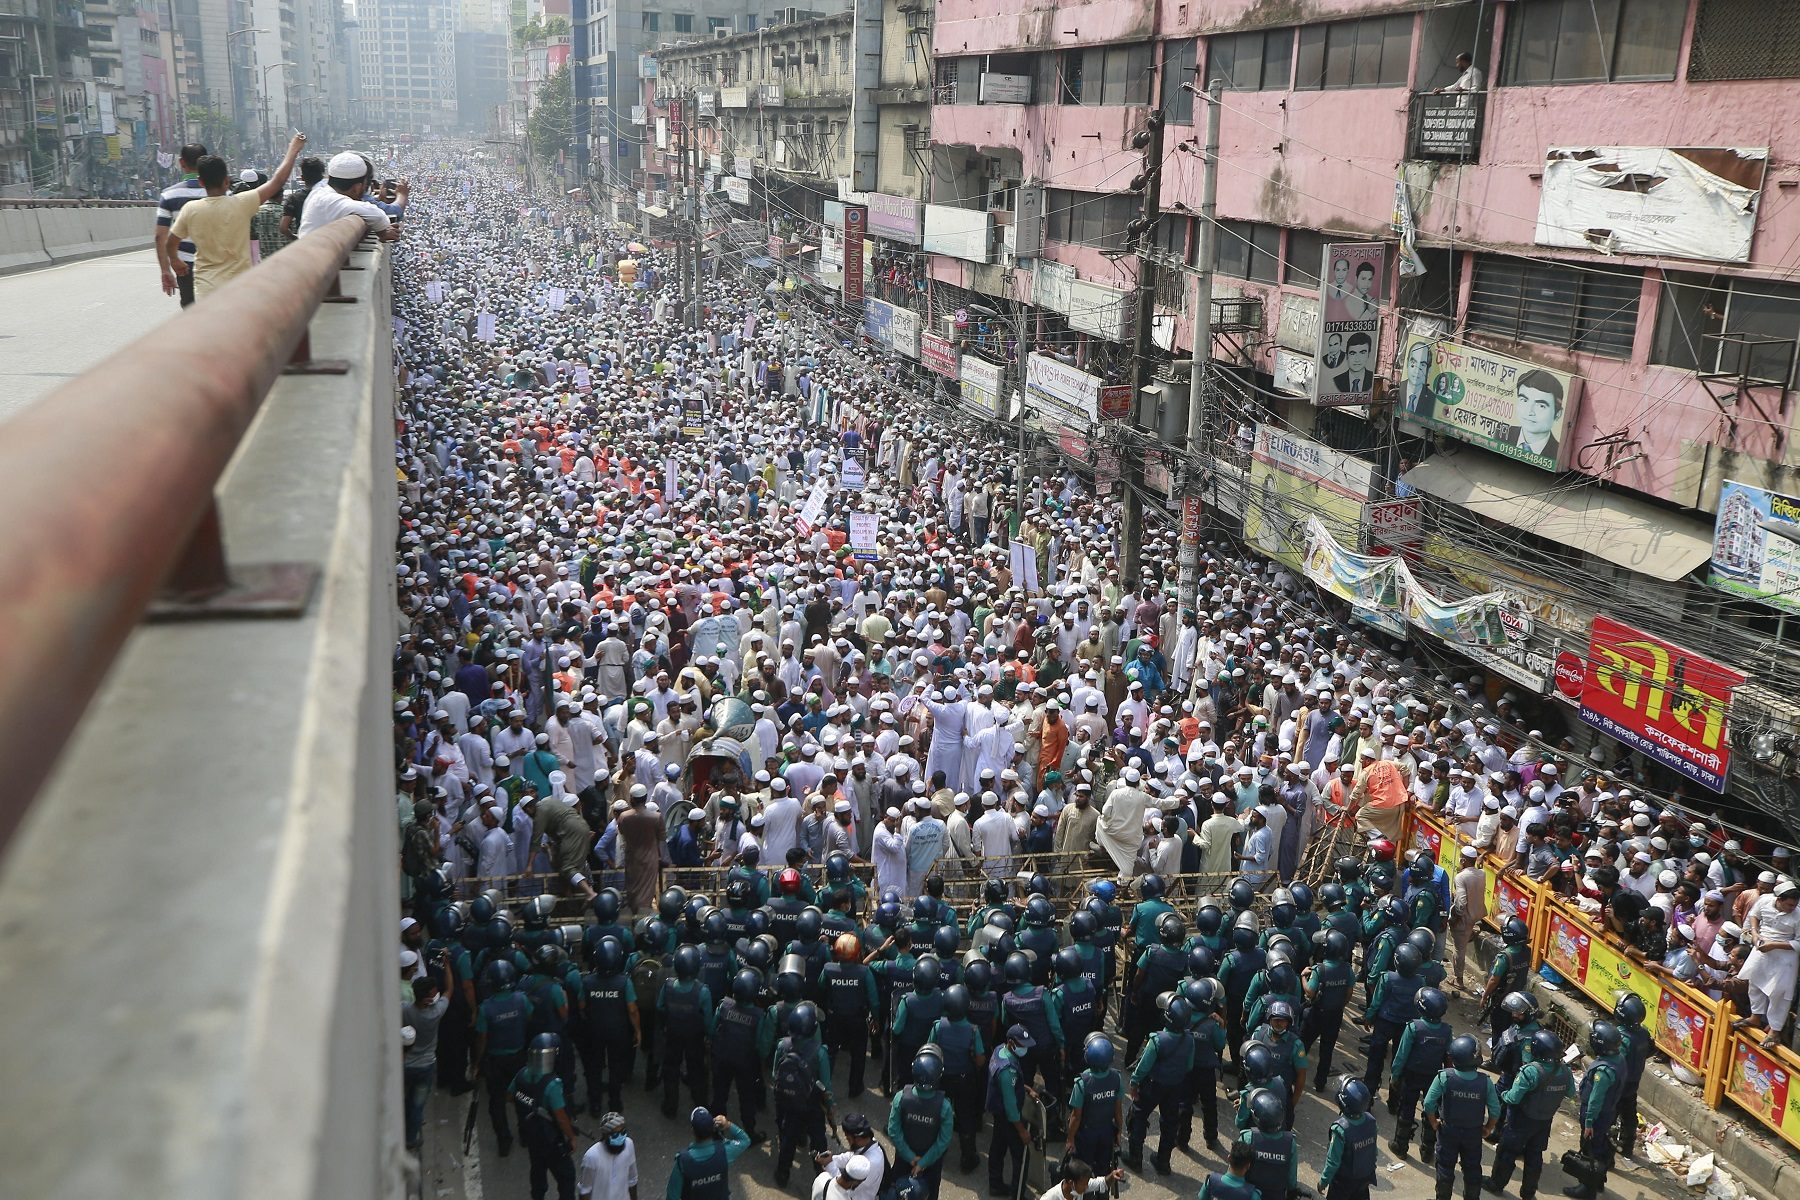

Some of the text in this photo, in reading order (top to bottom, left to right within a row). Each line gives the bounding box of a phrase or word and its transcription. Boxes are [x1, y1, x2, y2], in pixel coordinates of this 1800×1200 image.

[900, 201, 915, 220] Food
[849, 224, 860, 301] New Mood Food
[1325, 320, 1377, 332] 01714338361
[1470, 355, 1499, 377] মাথায়
[1499, 364, 1518, 386] চুল
[1453, 407, 1478, 428] হেয়ার
[1499, 443, 1553, 469] 01913-448453
[1370, 501, 1420, 524] রয়েল
[1614, 724, 1640, 744] কাকরাইল
[1644, 723, 1722, 771] কনফেকশনারী
[832, 978, 859, 986] POLICE
[1071, 1002, 1092, 1013] POLICE
[1092, 1089, 1115, 1101] POLICE
[1453, 1090, 1481, 1100] POLICE
[907, 1112, 934, 1124] POLICE
[1353, 1137, 1375, 1150] POLICE
[1257, 1151, 1286, 1162] POLICE
[691, 1173, 722, 1187] POLICE
